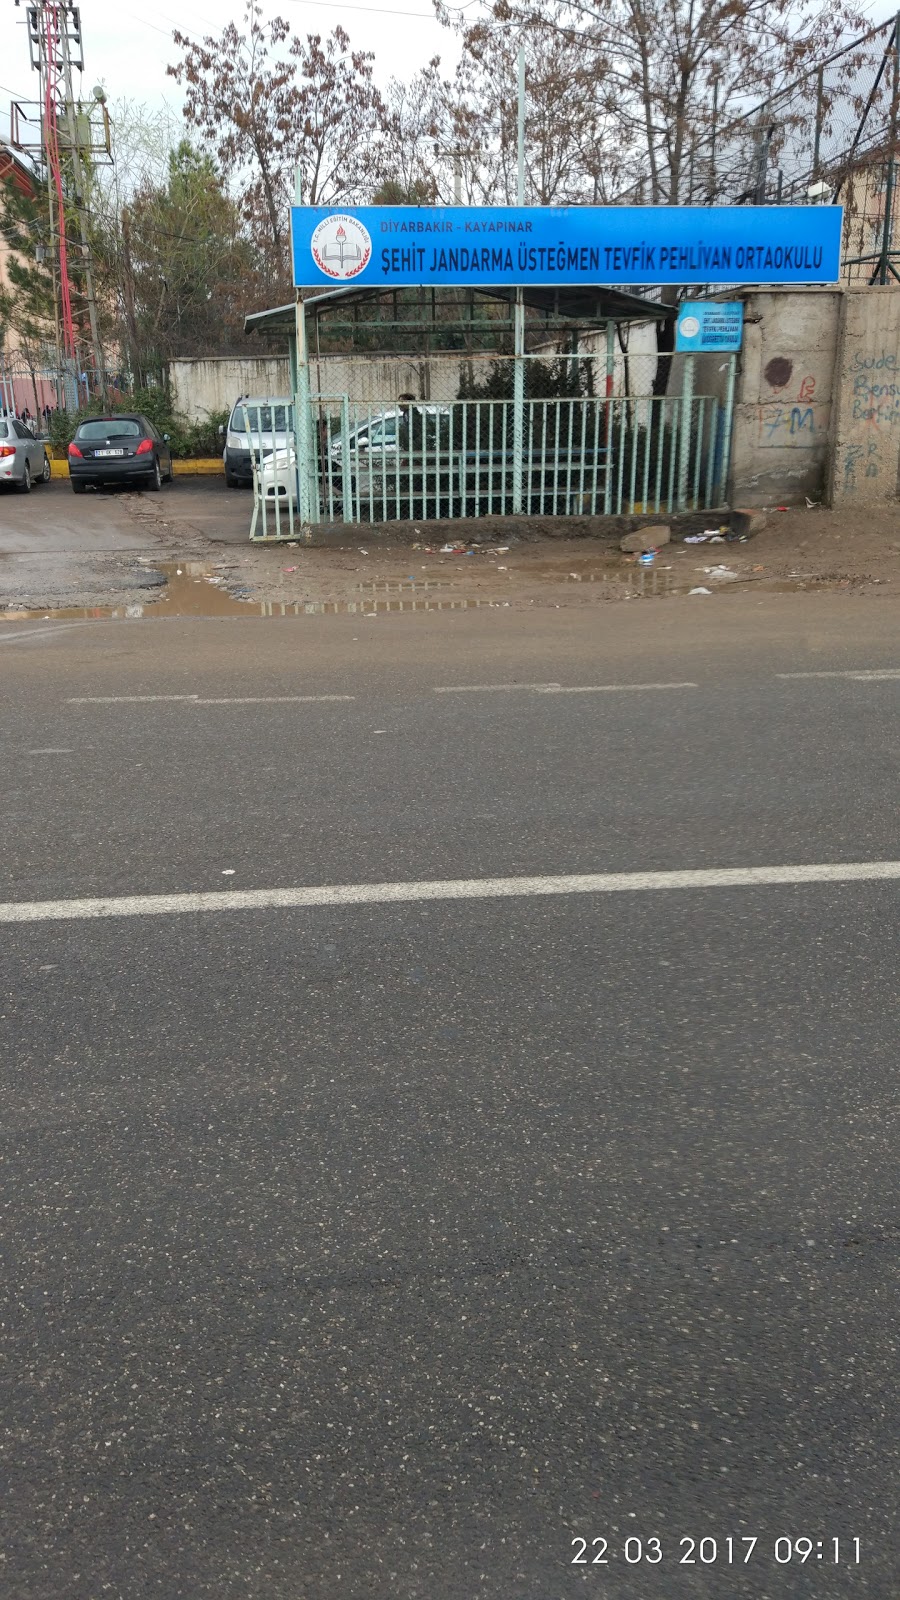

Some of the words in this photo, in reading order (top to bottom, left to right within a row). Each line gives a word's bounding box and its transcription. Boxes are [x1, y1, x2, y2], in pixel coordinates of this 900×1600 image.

[380, 218, 453, 233] DİYARBAKIR
[465, 221, 533, 233] KAYAPINAR
[381, 241, 425, 275] ŞEHİT
[430, 247, 514, 272] JANDARMA
[518, 240, 600, 271] ÜSTEĞMEN
[604, 240, 655, 270] TEVFİK
[660, 240, 731, 270] PEHLİVAN
[736, 246, 823, 269] ORTAOKULU
